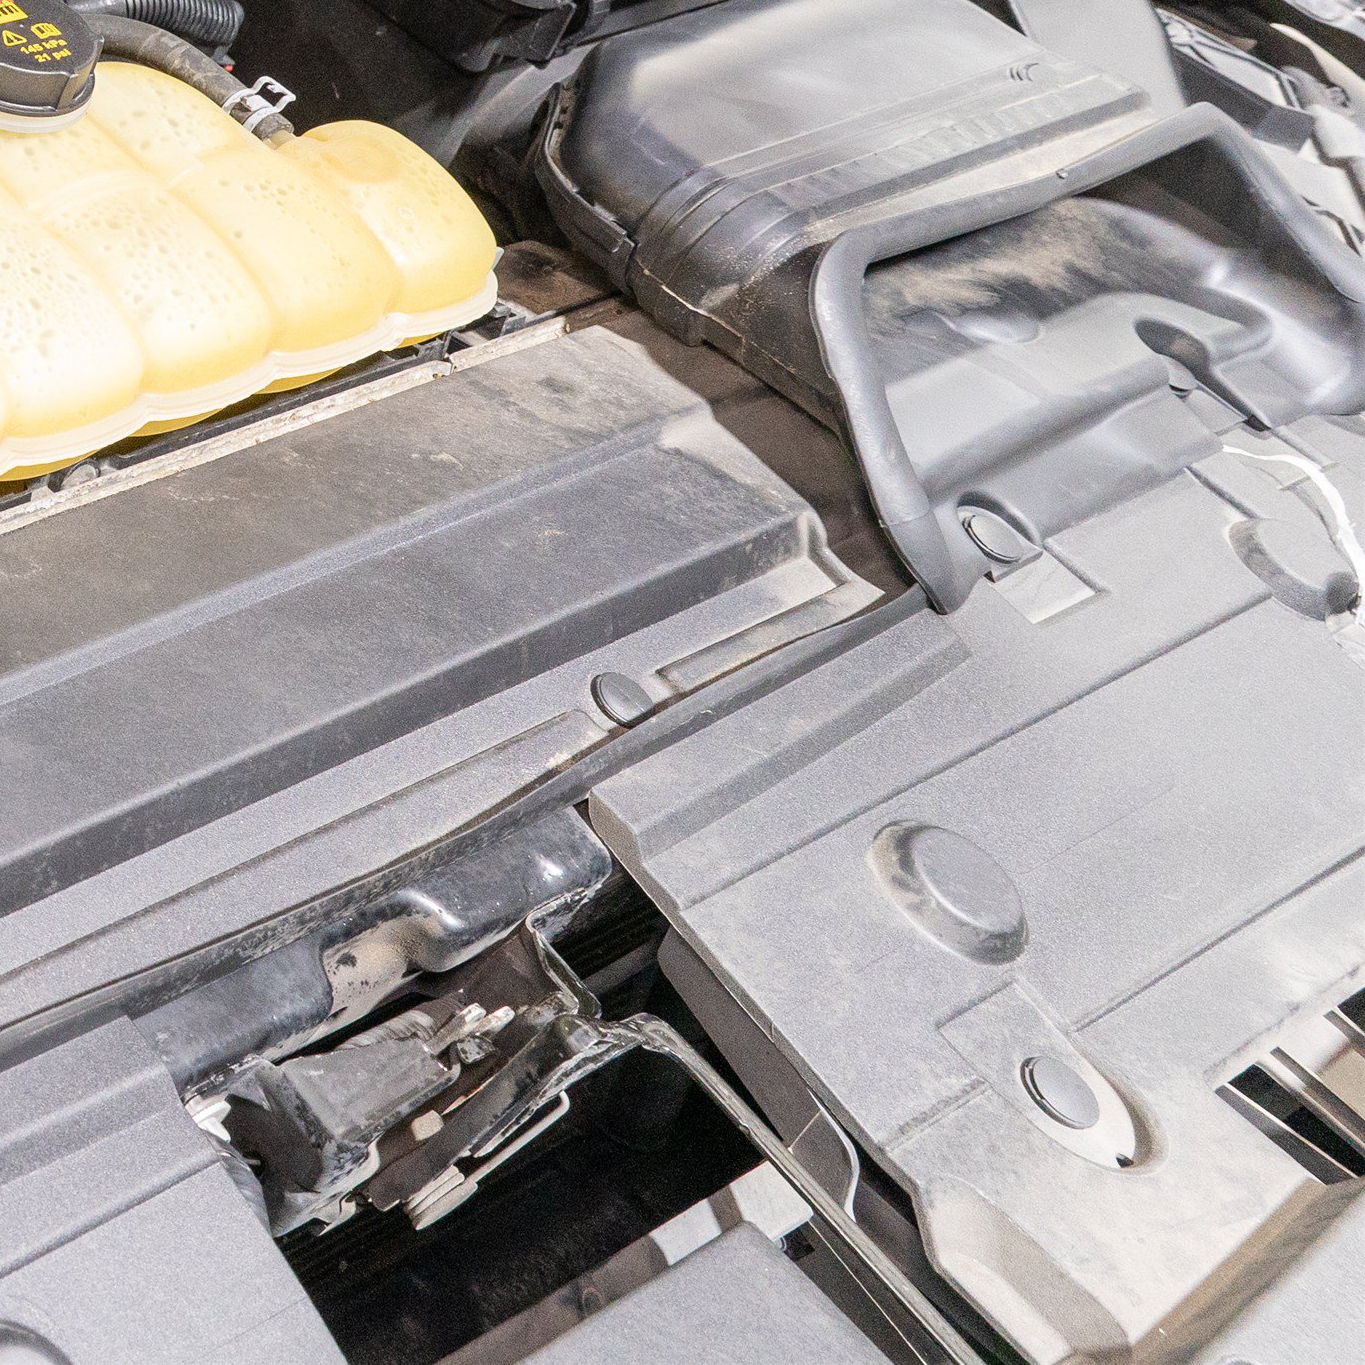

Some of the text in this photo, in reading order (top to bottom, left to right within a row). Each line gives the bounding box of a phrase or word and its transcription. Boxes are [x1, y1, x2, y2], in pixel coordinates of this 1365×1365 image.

[19, 35, 68, 56] 145 kPa
[34, 47, 72, 63] 21 psi
